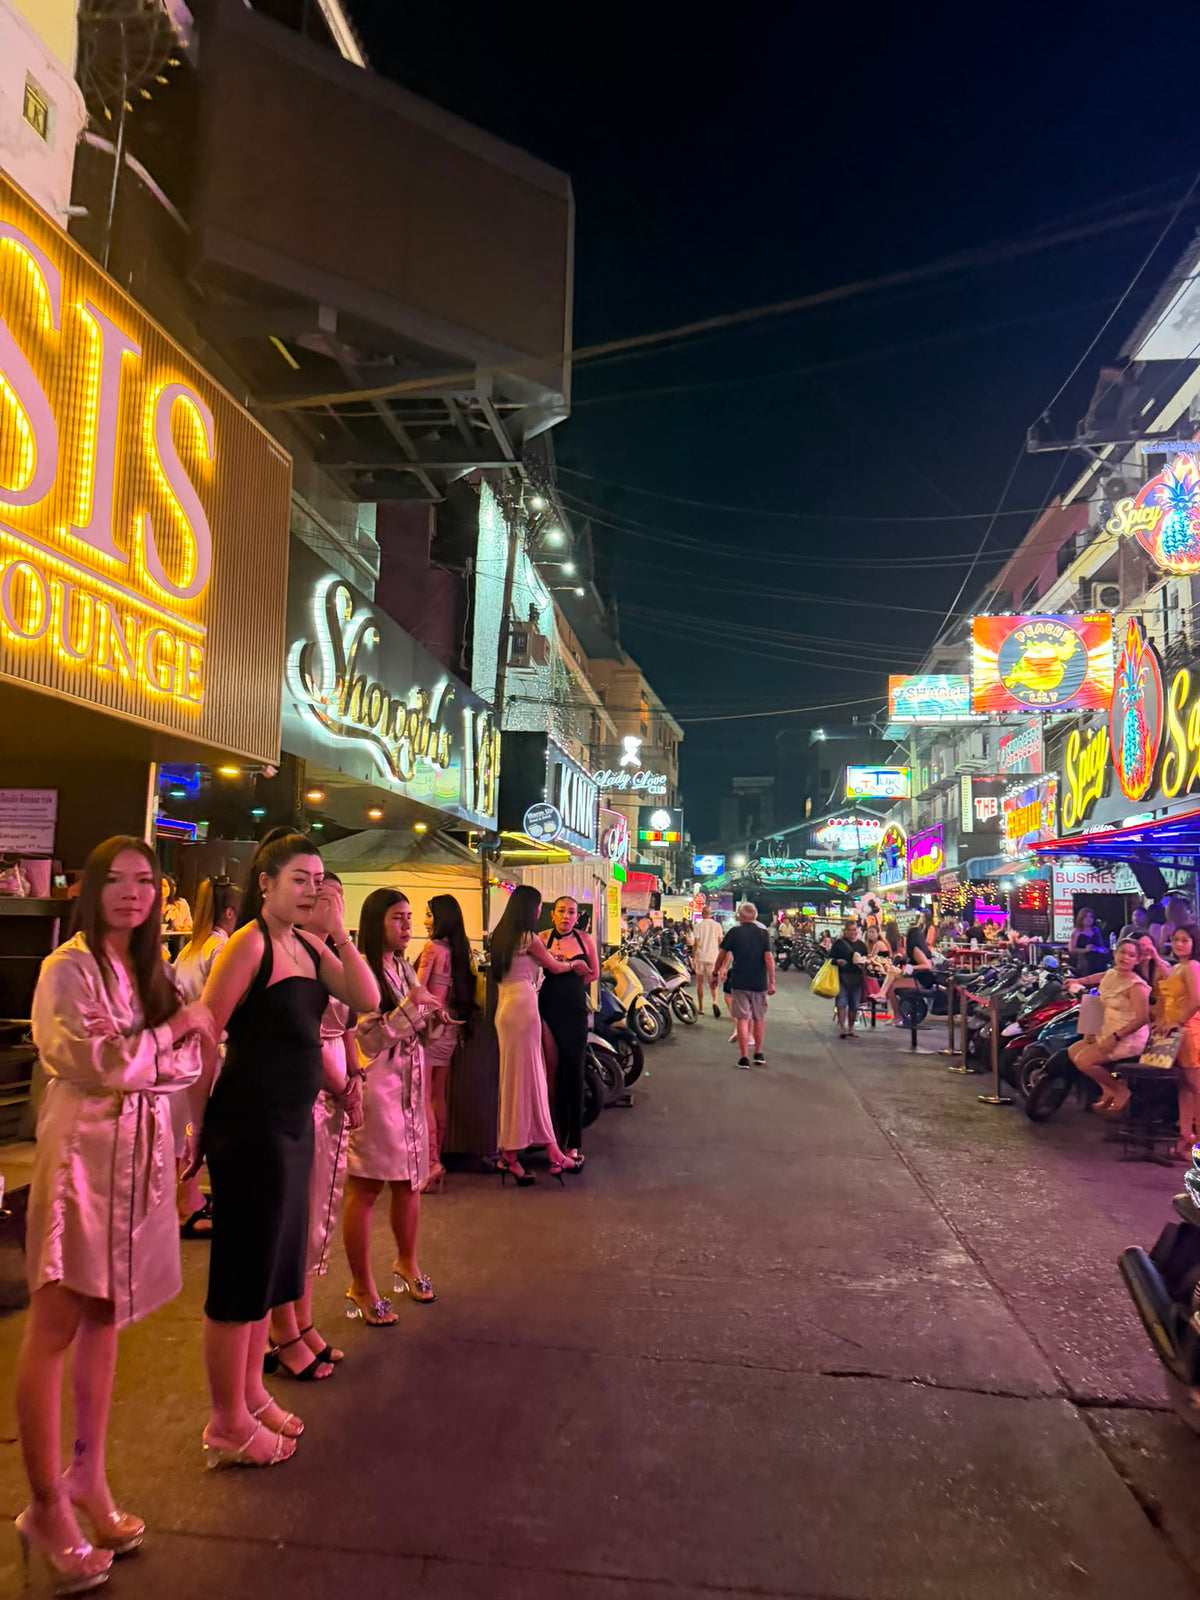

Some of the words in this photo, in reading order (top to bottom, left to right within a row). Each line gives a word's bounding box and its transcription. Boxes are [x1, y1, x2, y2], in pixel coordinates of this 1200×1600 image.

[1107, 498, 1163, 537] Spicy
[593, 769, 631, 790] Lady
[631, 769, 667, 790] Love
[1062, 725, 1110, 829] Spicy
[559, 762, 596, 839] KINK
[975, 799, 996, 819] THE
